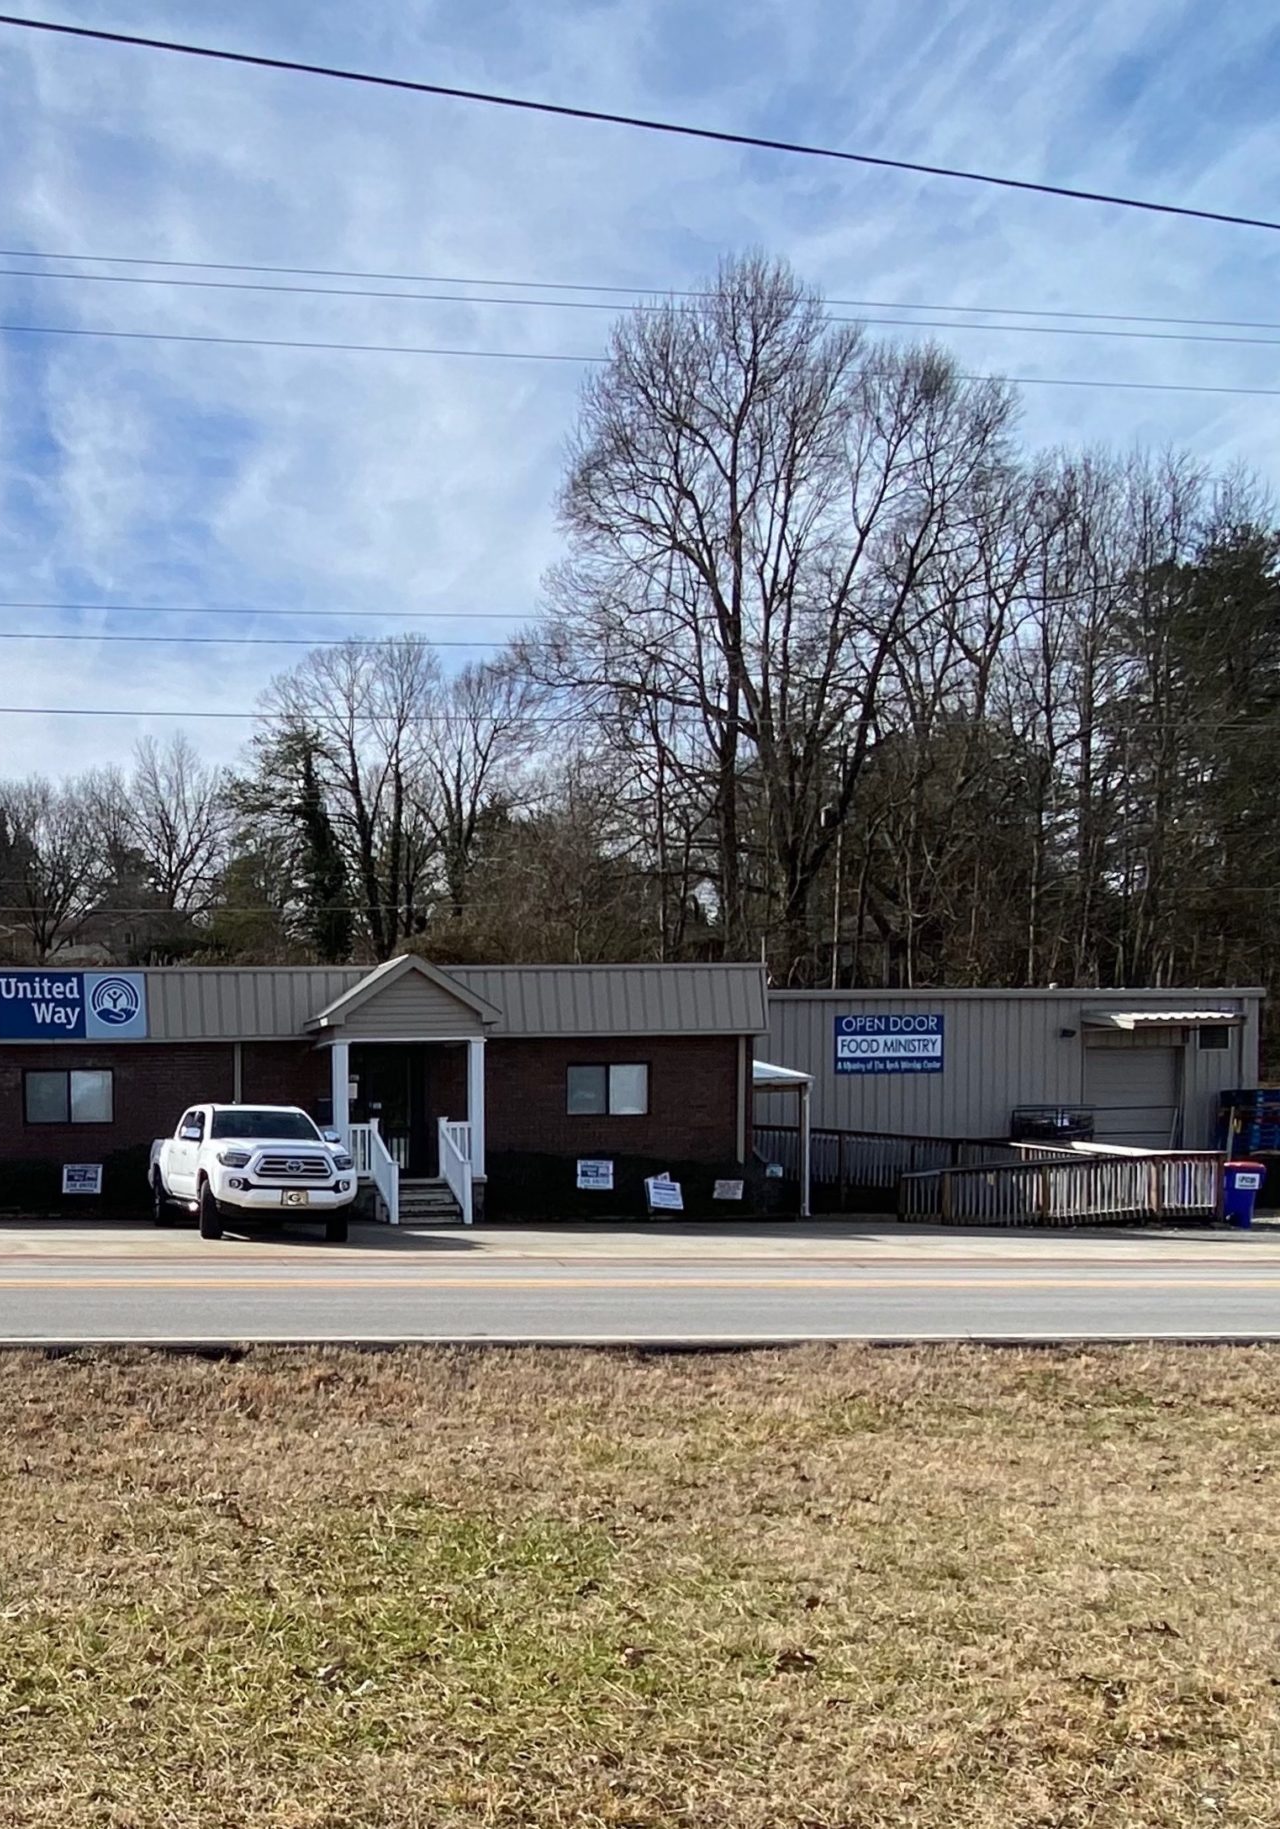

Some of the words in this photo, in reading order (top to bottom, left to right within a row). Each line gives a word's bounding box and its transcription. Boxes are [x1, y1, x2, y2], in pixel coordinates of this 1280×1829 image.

[0, 977, 80, 999] United
[31, 1002, 80, 1029] Way
[842, 1016, 885, 1032] OPEN
[889, 1016, 937, 1031] DOOR
[840, 1038, 880, 1054] FOOD
[882, 1038, 937, 1053] MINISTRY
